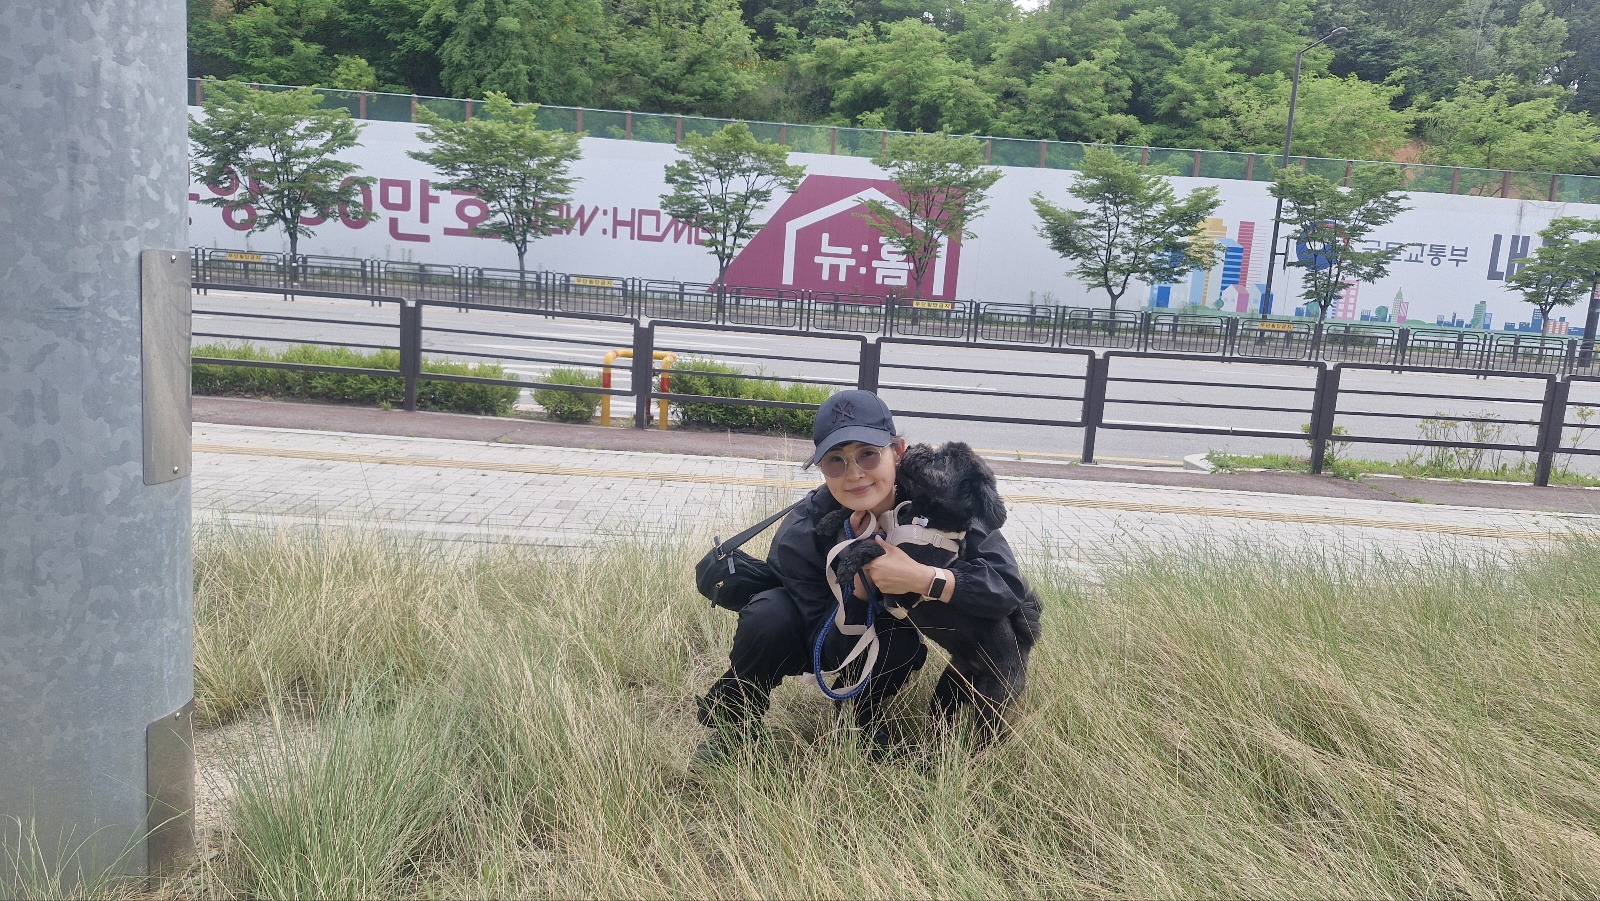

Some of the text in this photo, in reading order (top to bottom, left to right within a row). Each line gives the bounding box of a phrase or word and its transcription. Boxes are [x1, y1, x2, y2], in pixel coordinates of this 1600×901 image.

[814, 232, 914, 287] 뉴:홈
[1361, 238, 1469, 267] 국토교통부
[915, 301, 951, 309] 무단횡단금지
[832, 400, 855, 424] NY
